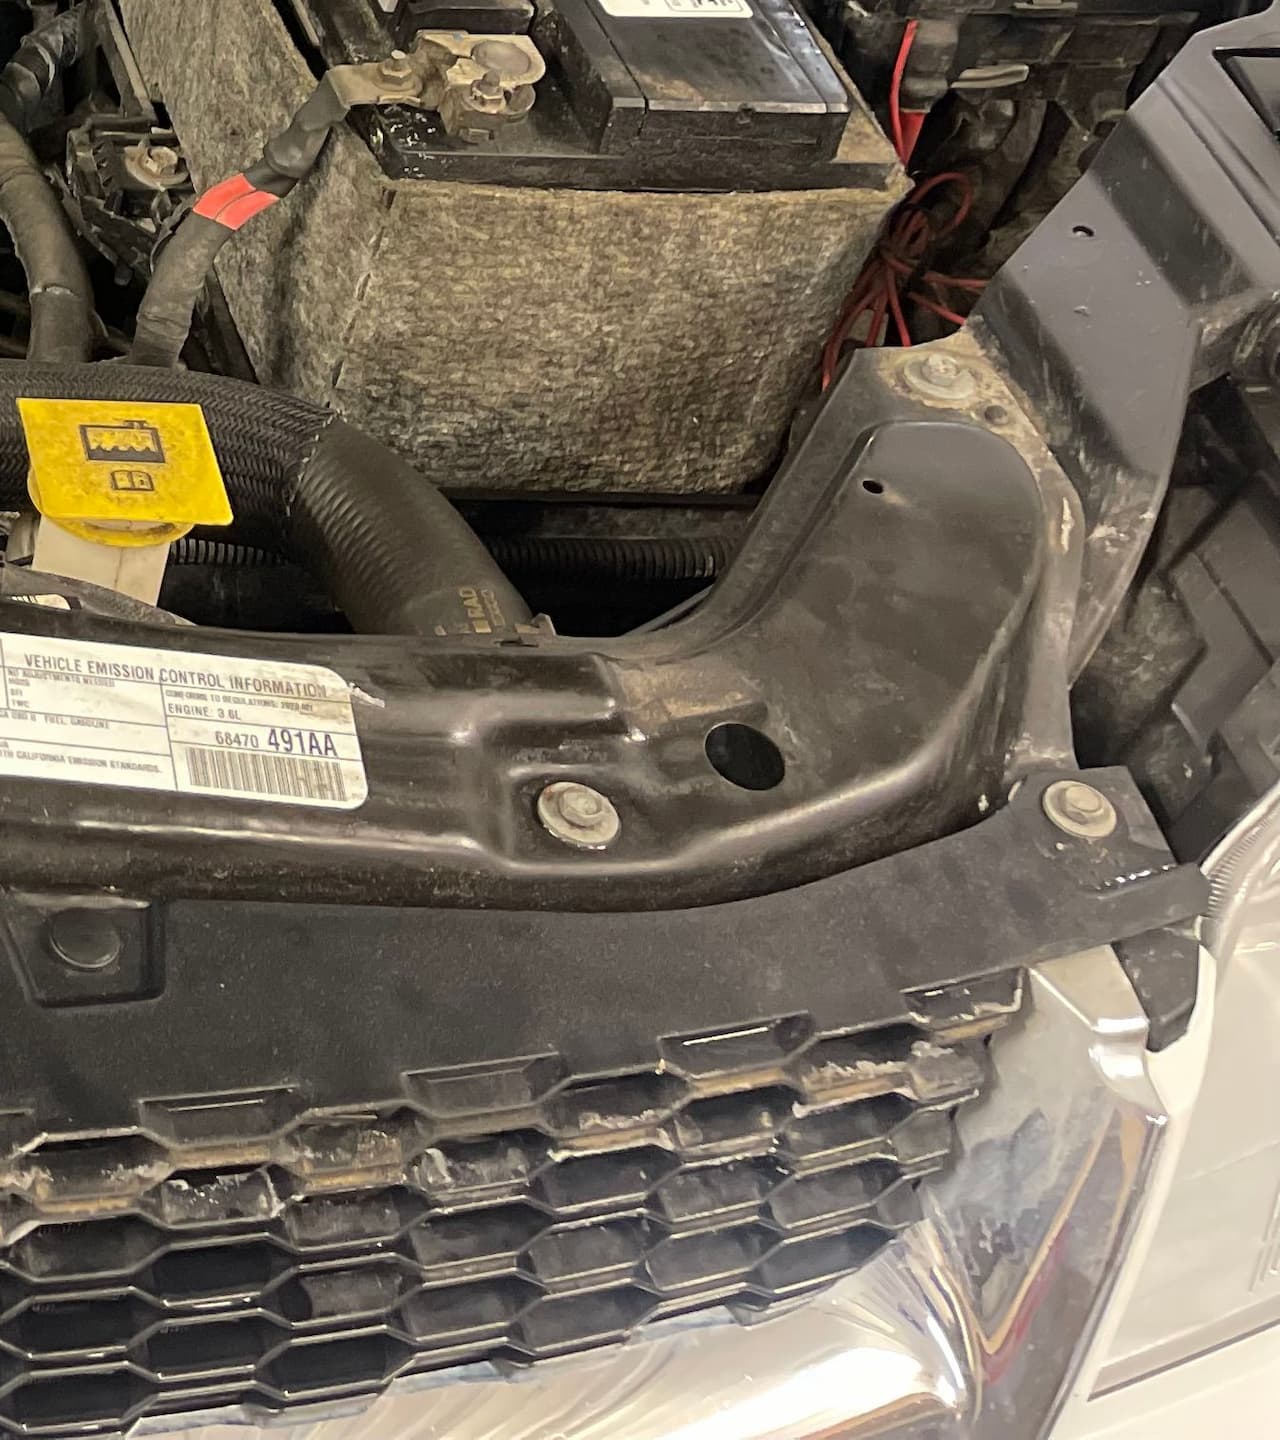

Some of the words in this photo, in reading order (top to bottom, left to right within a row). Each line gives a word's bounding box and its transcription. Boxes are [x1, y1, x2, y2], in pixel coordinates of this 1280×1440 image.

[24, 653, 82, 673] VEHICLE
[87, 660, 154, 680] EMISSION
[159, 668, 225, 688] CONTROL
[229, 675, 327, 698] INFORMATION
[215, 730, 260, 748] 68470
[267, 728, 338, 757] 491AA
